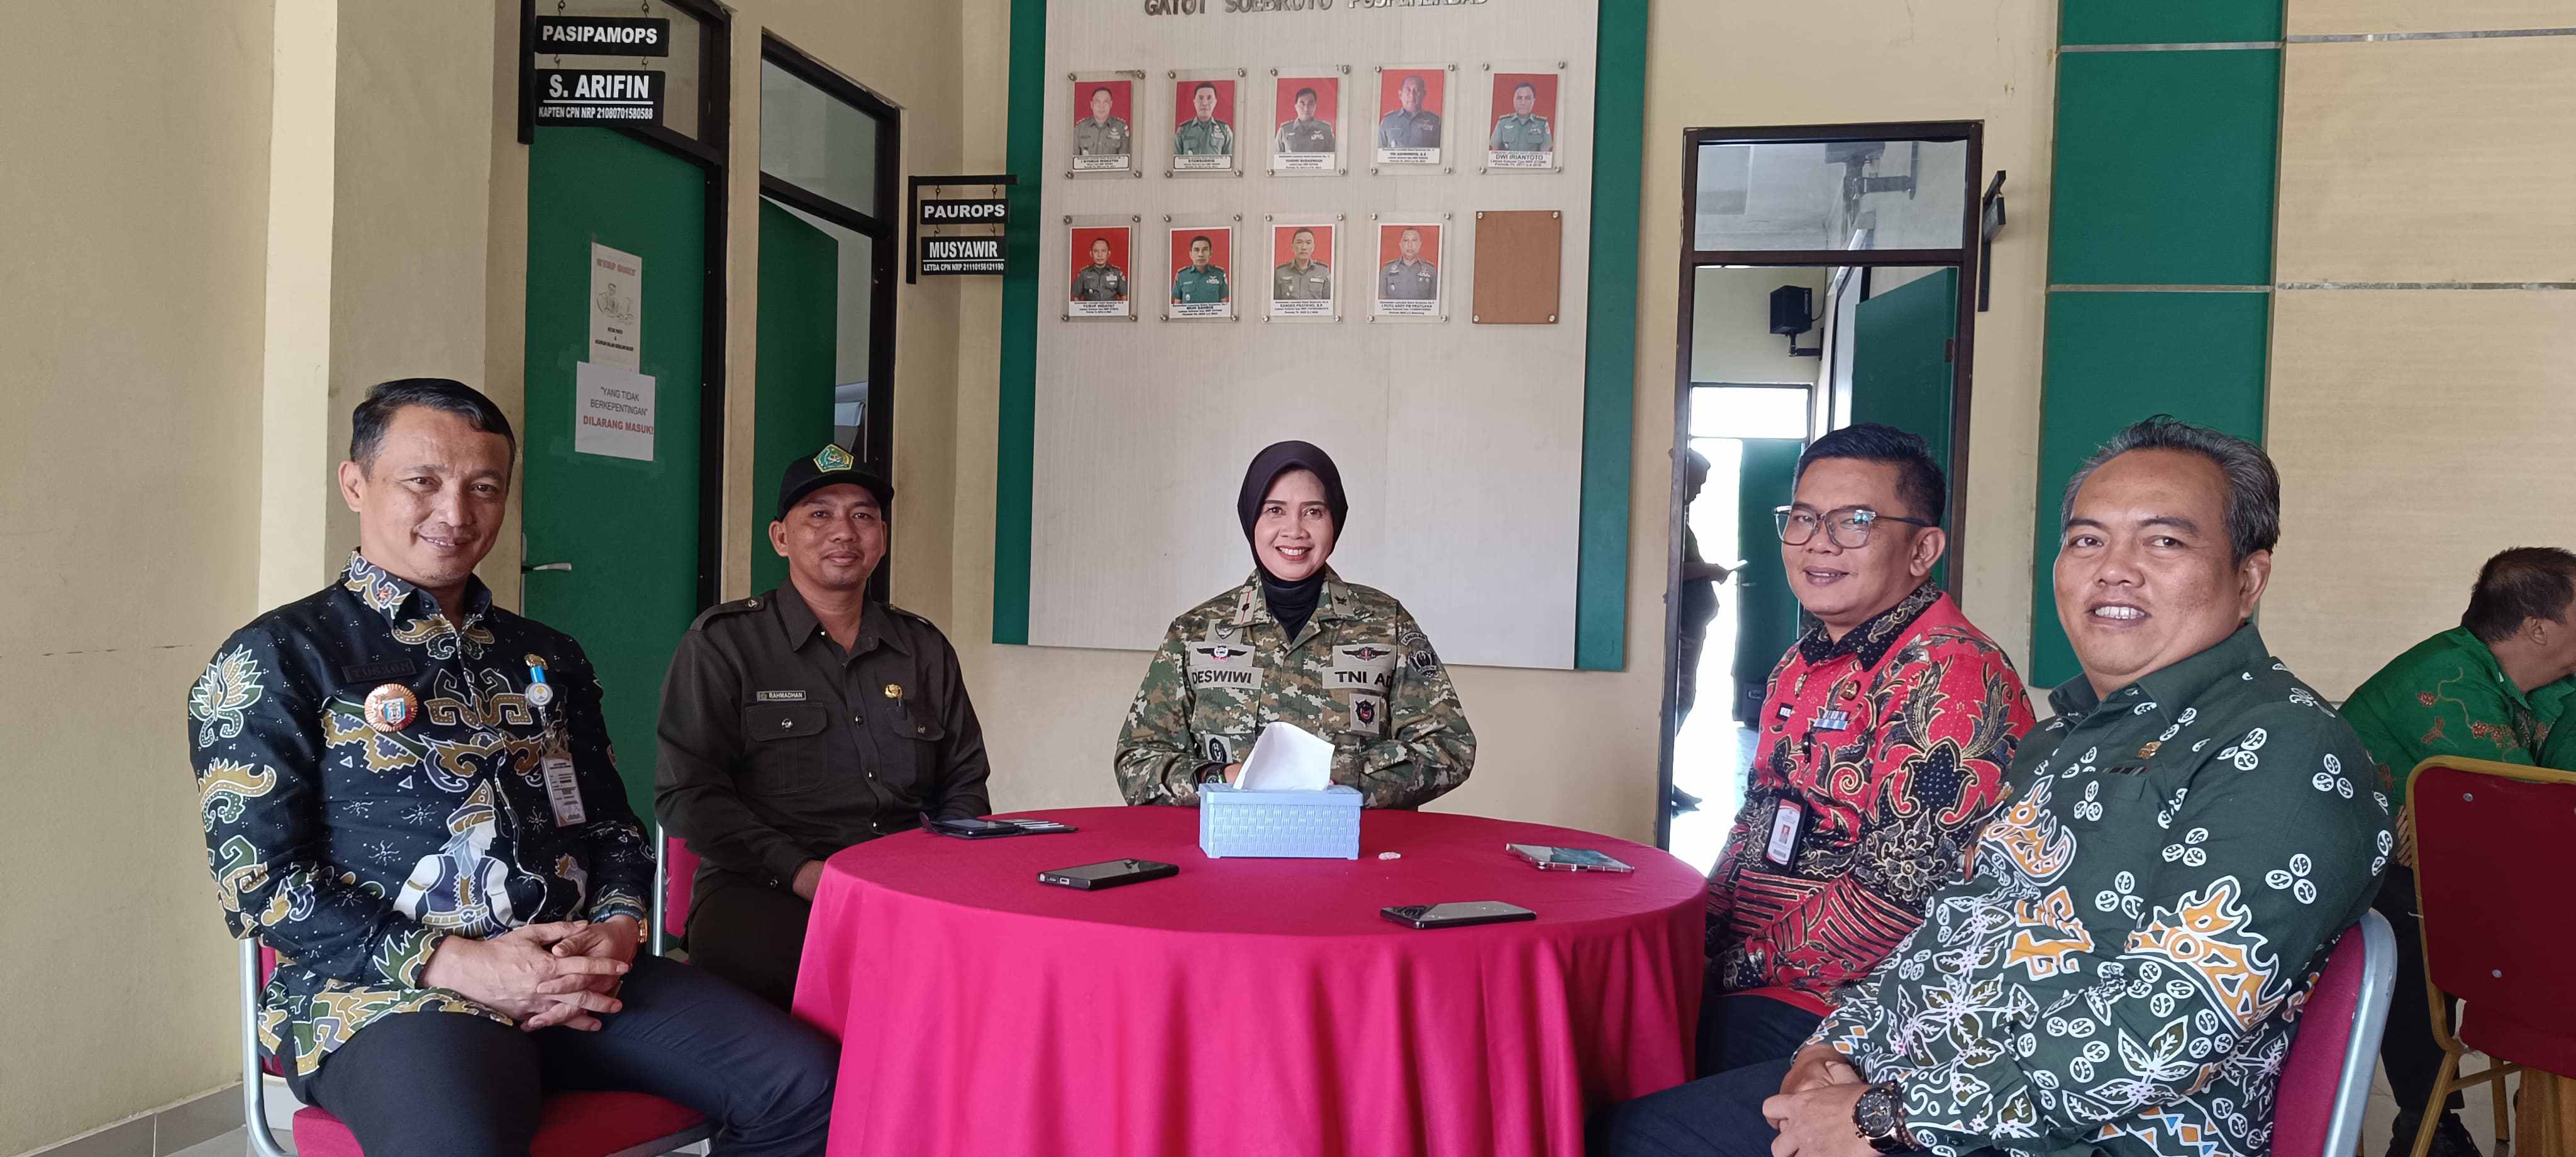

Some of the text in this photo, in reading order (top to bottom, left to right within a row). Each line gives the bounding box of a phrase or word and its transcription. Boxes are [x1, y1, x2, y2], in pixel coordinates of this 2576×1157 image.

[543, 25, 657, 44] PASIPAMOPS
[549, 74, 649, 99] S. ARIFIN
[538, 106, 653, 119] KAPTEN CPN NRP 21080701580588
[924, 204, 1005, 218] PAUROPS
[930, 241, 997, 258] MUSYAWIR
[621, 390, 640, 402] TIDAK
[583, 414, 654, 435] DILARANG MASUK!
[1192, 670, 1252, 685] DESWIWI
[1334, 670, 1367, 684] TNI
